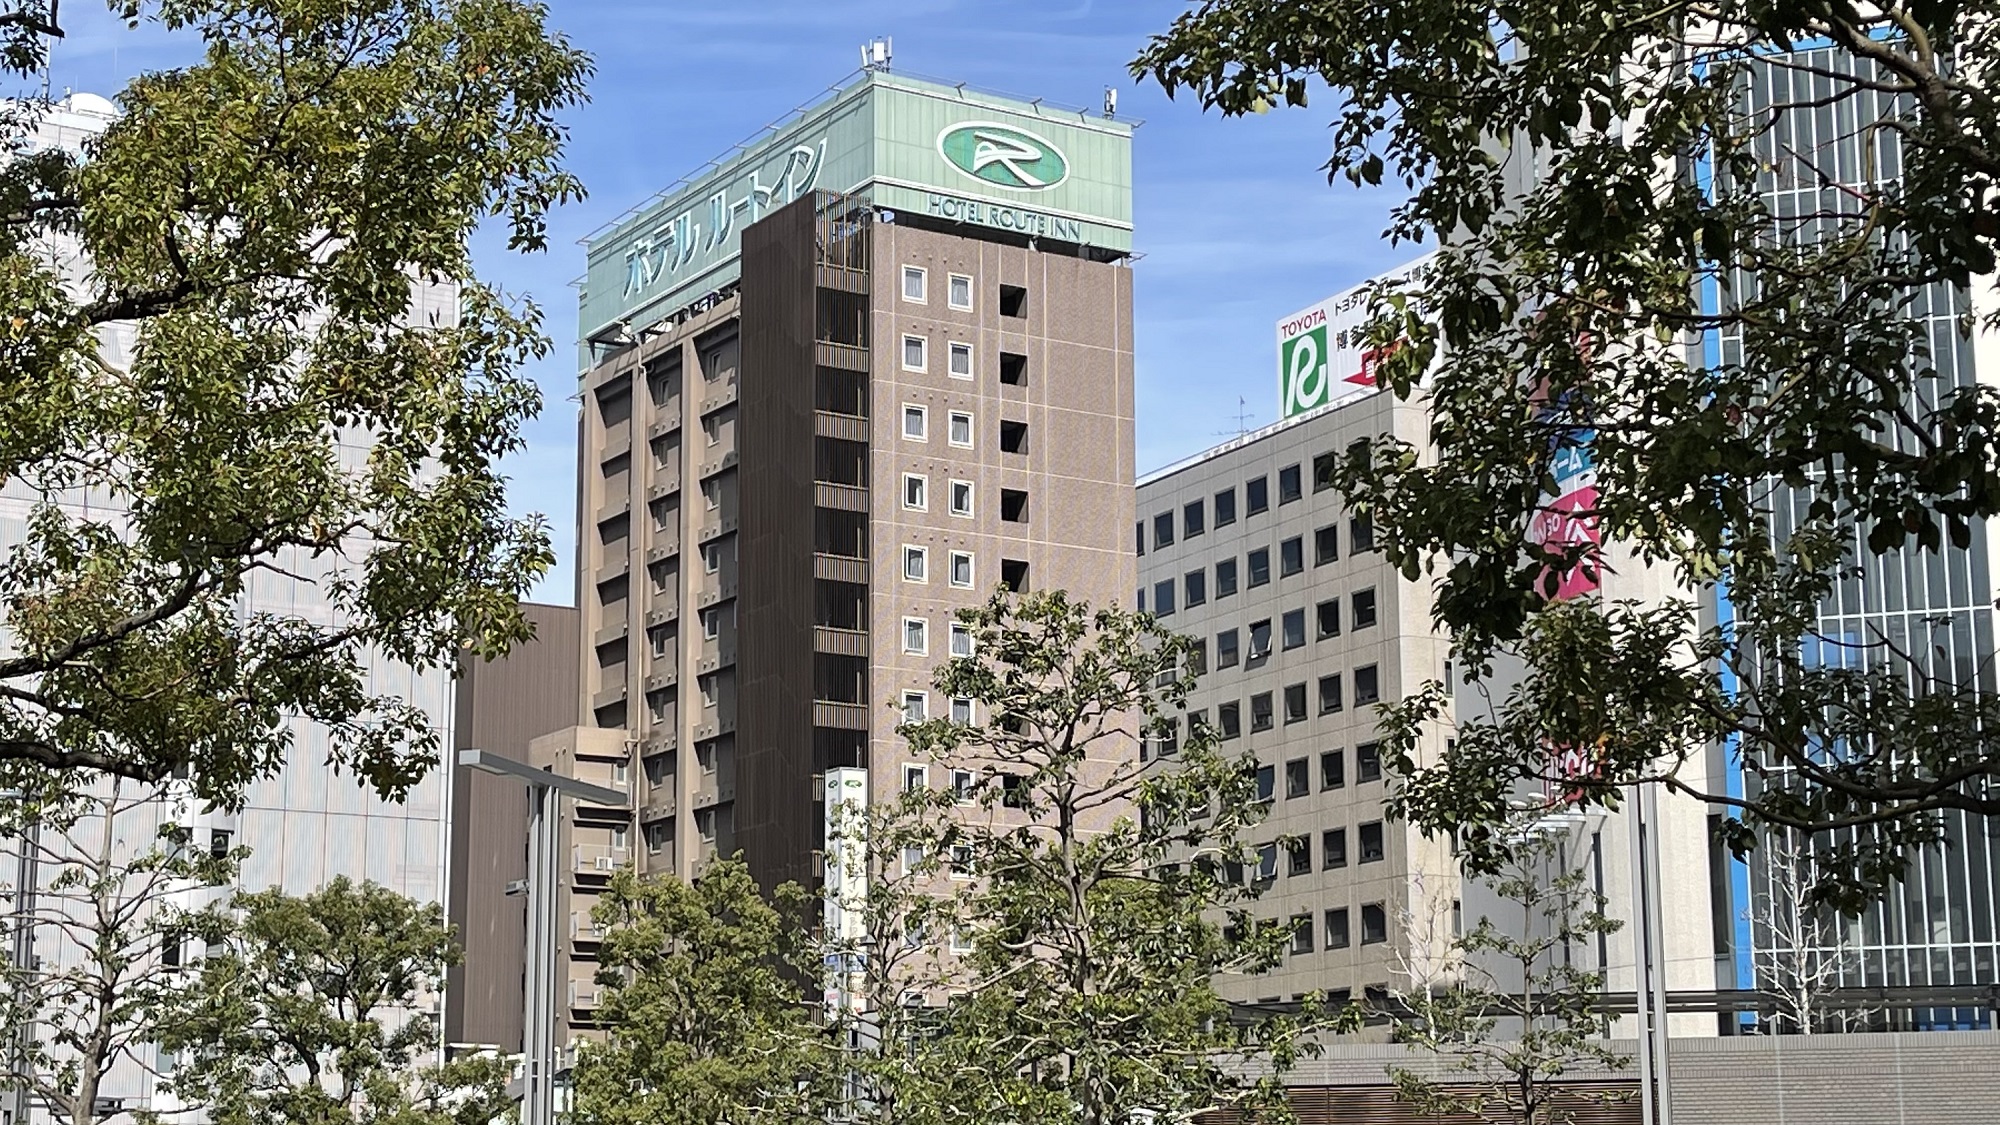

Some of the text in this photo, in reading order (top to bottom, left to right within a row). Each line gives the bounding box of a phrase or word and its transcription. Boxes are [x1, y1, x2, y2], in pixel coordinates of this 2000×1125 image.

[927, 194, 1081, 240] HOTEL ROUTE INN
[1281, 309, 1327, 339] TOYOTA
